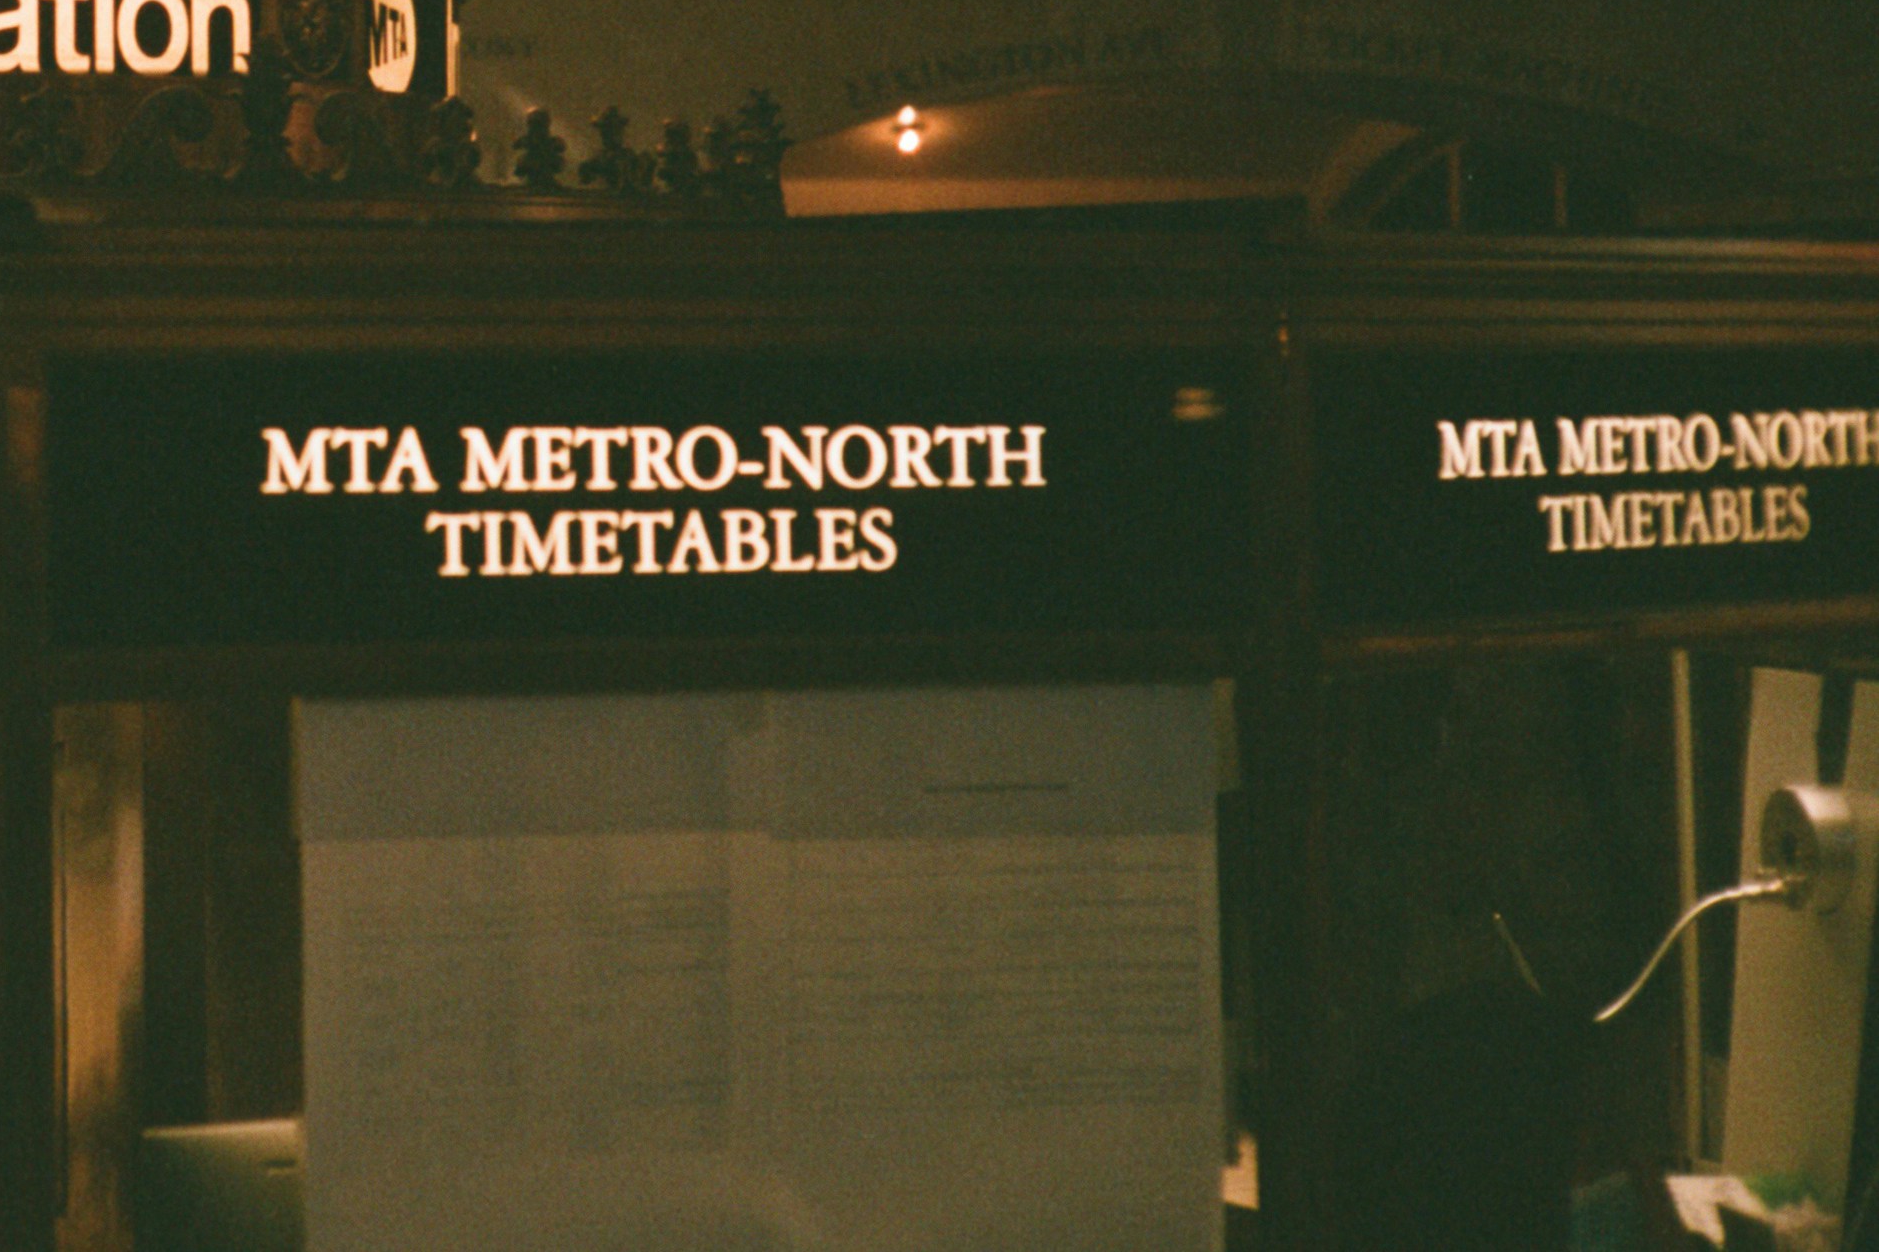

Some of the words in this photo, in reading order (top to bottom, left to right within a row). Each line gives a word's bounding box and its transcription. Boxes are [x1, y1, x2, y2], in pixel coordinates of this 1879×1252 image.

[260, 426, 440, 496] MTA
[458, 423, 1048, 493] METRO-NORTH
[1436, 418, 1549, 480] MTA
[424, 507, 899, 577] TIMETABLES
[1537, 484, 1811, 554] TIMETABLES
